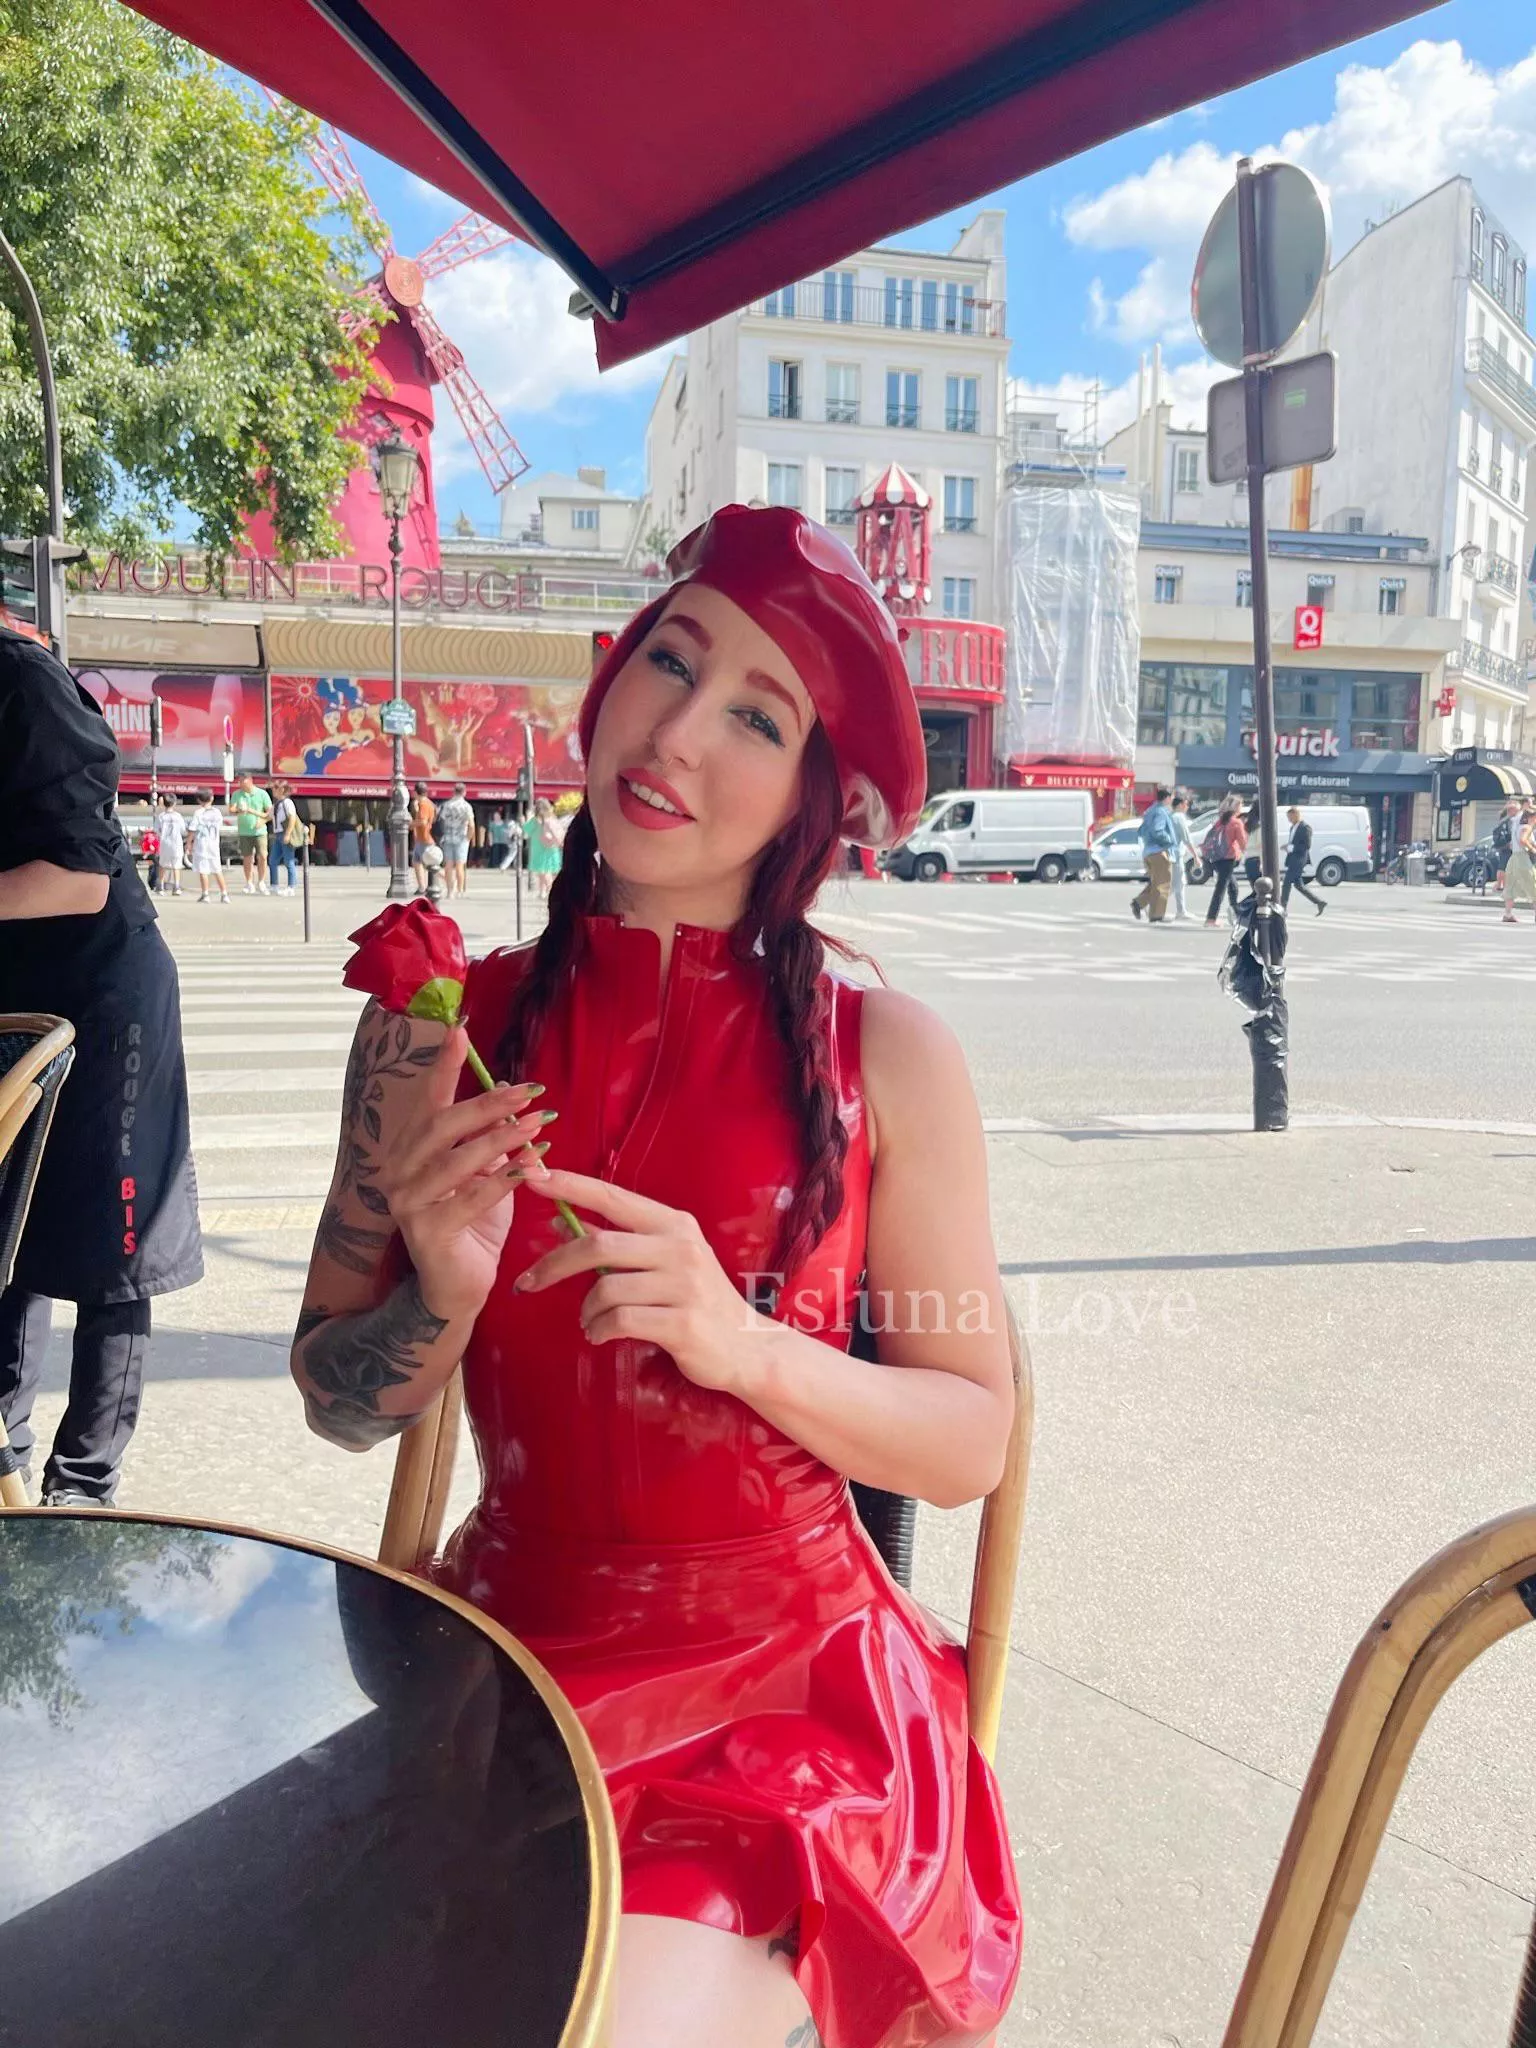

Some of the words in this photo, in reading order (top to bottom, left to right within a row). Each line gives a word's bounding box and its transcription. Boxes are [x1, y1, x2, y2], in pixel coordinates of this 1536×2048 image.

[76, 551, 296, 600] MOUIN
[359, 564, 544, 611] ROUGE
[1300, 609, 1319, 636] Q
[1228, 772, 1259, 787] Quality
[1275, 774, 1297, 788] urger
[1301, 774, 1350, 788] Restaurant
[121, 1176, 136, 1255] BIS
